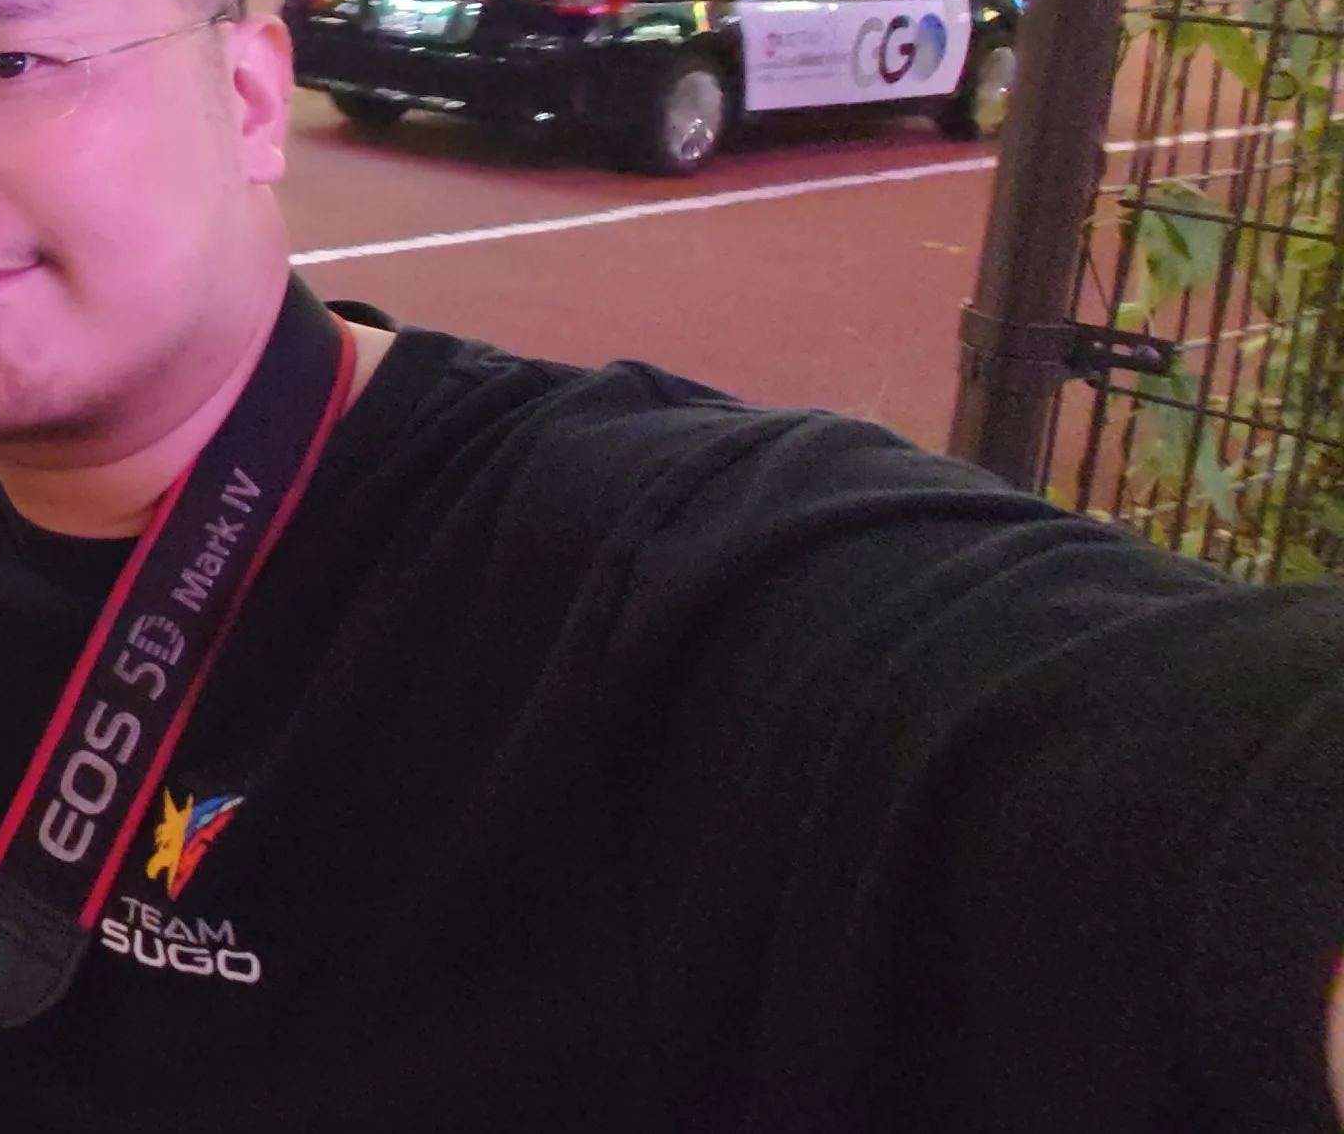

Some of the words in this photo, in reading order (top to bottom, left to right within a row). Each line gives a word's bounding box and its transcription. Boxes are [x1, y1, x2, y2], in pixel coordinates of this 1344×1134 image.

[38, 699, 142, 863] EOS
[114, 613, 187, 702] 5D
[170, 515, 244, 614] Mark
[219, 467, 263, 515] IV
[99, 919, 261, 984] SUGO
[121, 896, 236, 948] TEAM
